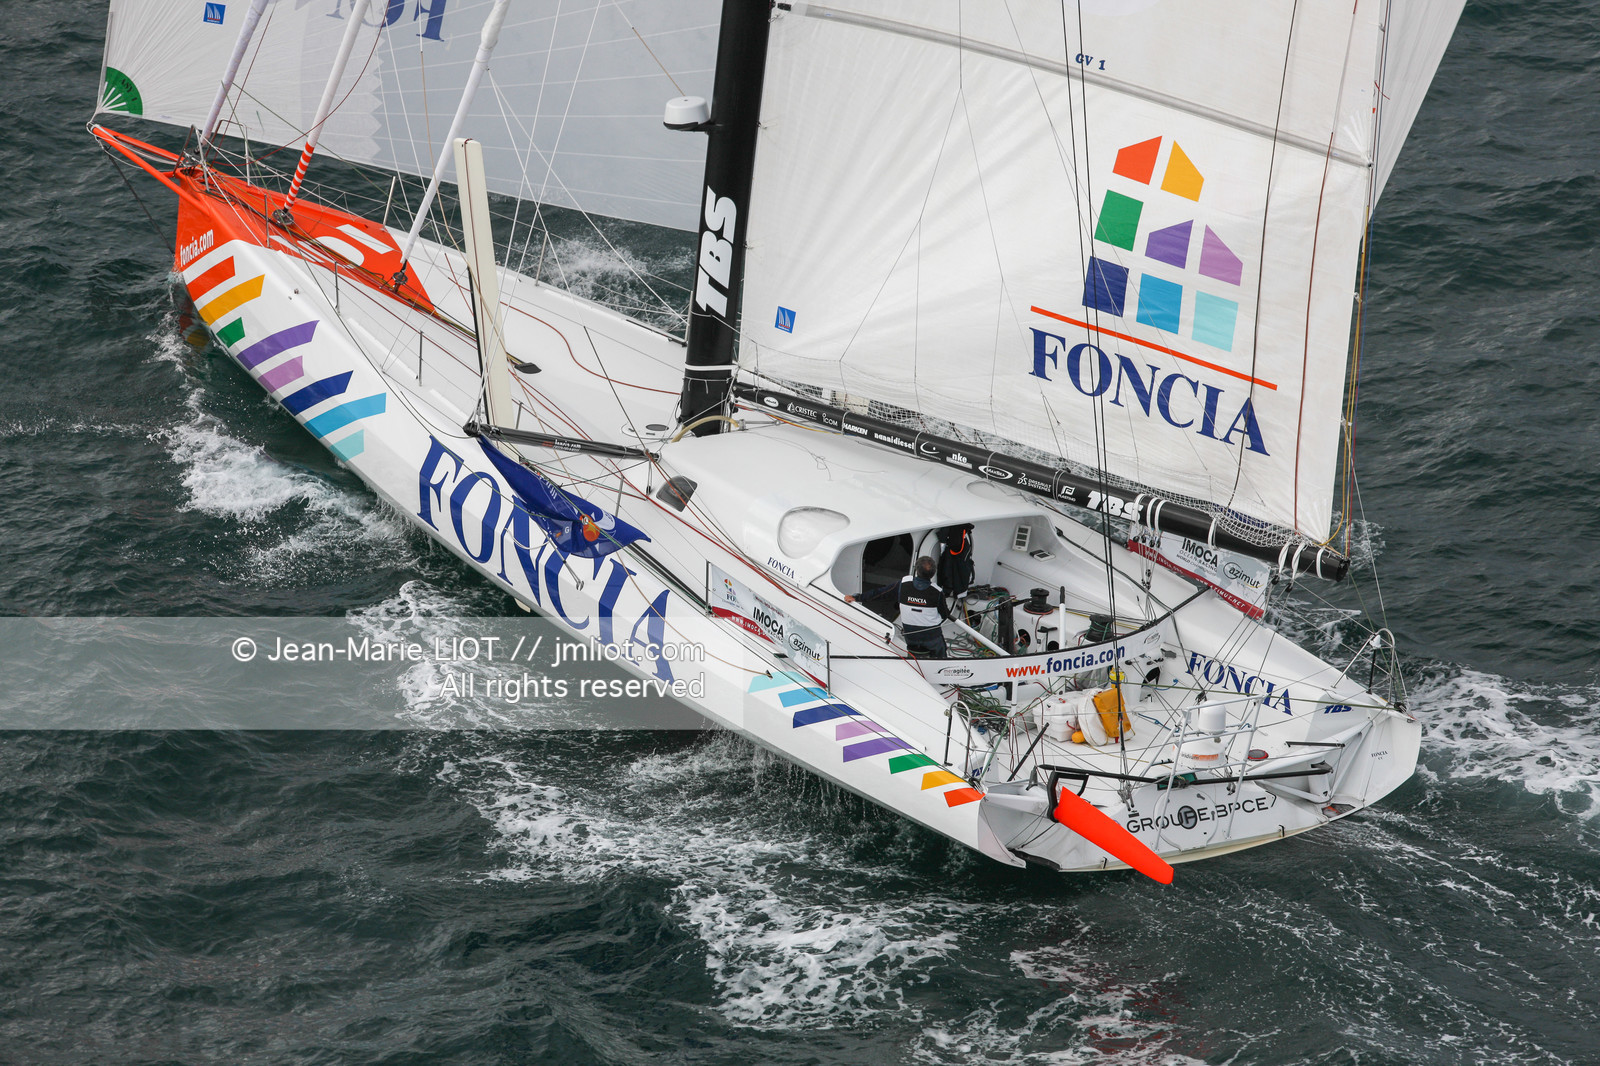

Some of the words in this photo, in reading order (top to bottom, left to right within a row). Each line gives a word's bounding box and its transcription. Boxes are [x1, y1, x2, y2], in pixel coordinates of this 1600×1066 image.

[1075, 53, 1094, 66] GV
[1098, 60, 1106, 70] 1
[180, 229, 214, 268] foncia.com
[695, 185, 738, 318] TBS
[1028, 327, 1271, 457] FONCIA
[795, 405, 818, 418] CRISTEC
[874, 432, 915, 450] nannidiesel
[951, 453, 968, 464] nke
[1086, 490, 1145, 522] TBS
[416, 435, 677, 687] FONCIA
[1182, 537, 1218, 568] IMOCA
[767, 556, 795, 580] FONCIA
[1228, 566, 1262, 589] azimut
[907, 596, 927, 604] FONCIA
[753, 606, 785, 639] IMOCA
[793, 637, 821, 661] azimut
[1006, 646, 1125, 678] www.foncia.com
[1185, 651, 1294, 717] FONCIA
[1323, 704, 1352, 714] TBS
[1371, 750, 1388, 758] FONCIA
[1126, 807, 1210, 834] GROUPE
[1215, 797, 1269, 818] BPCE
